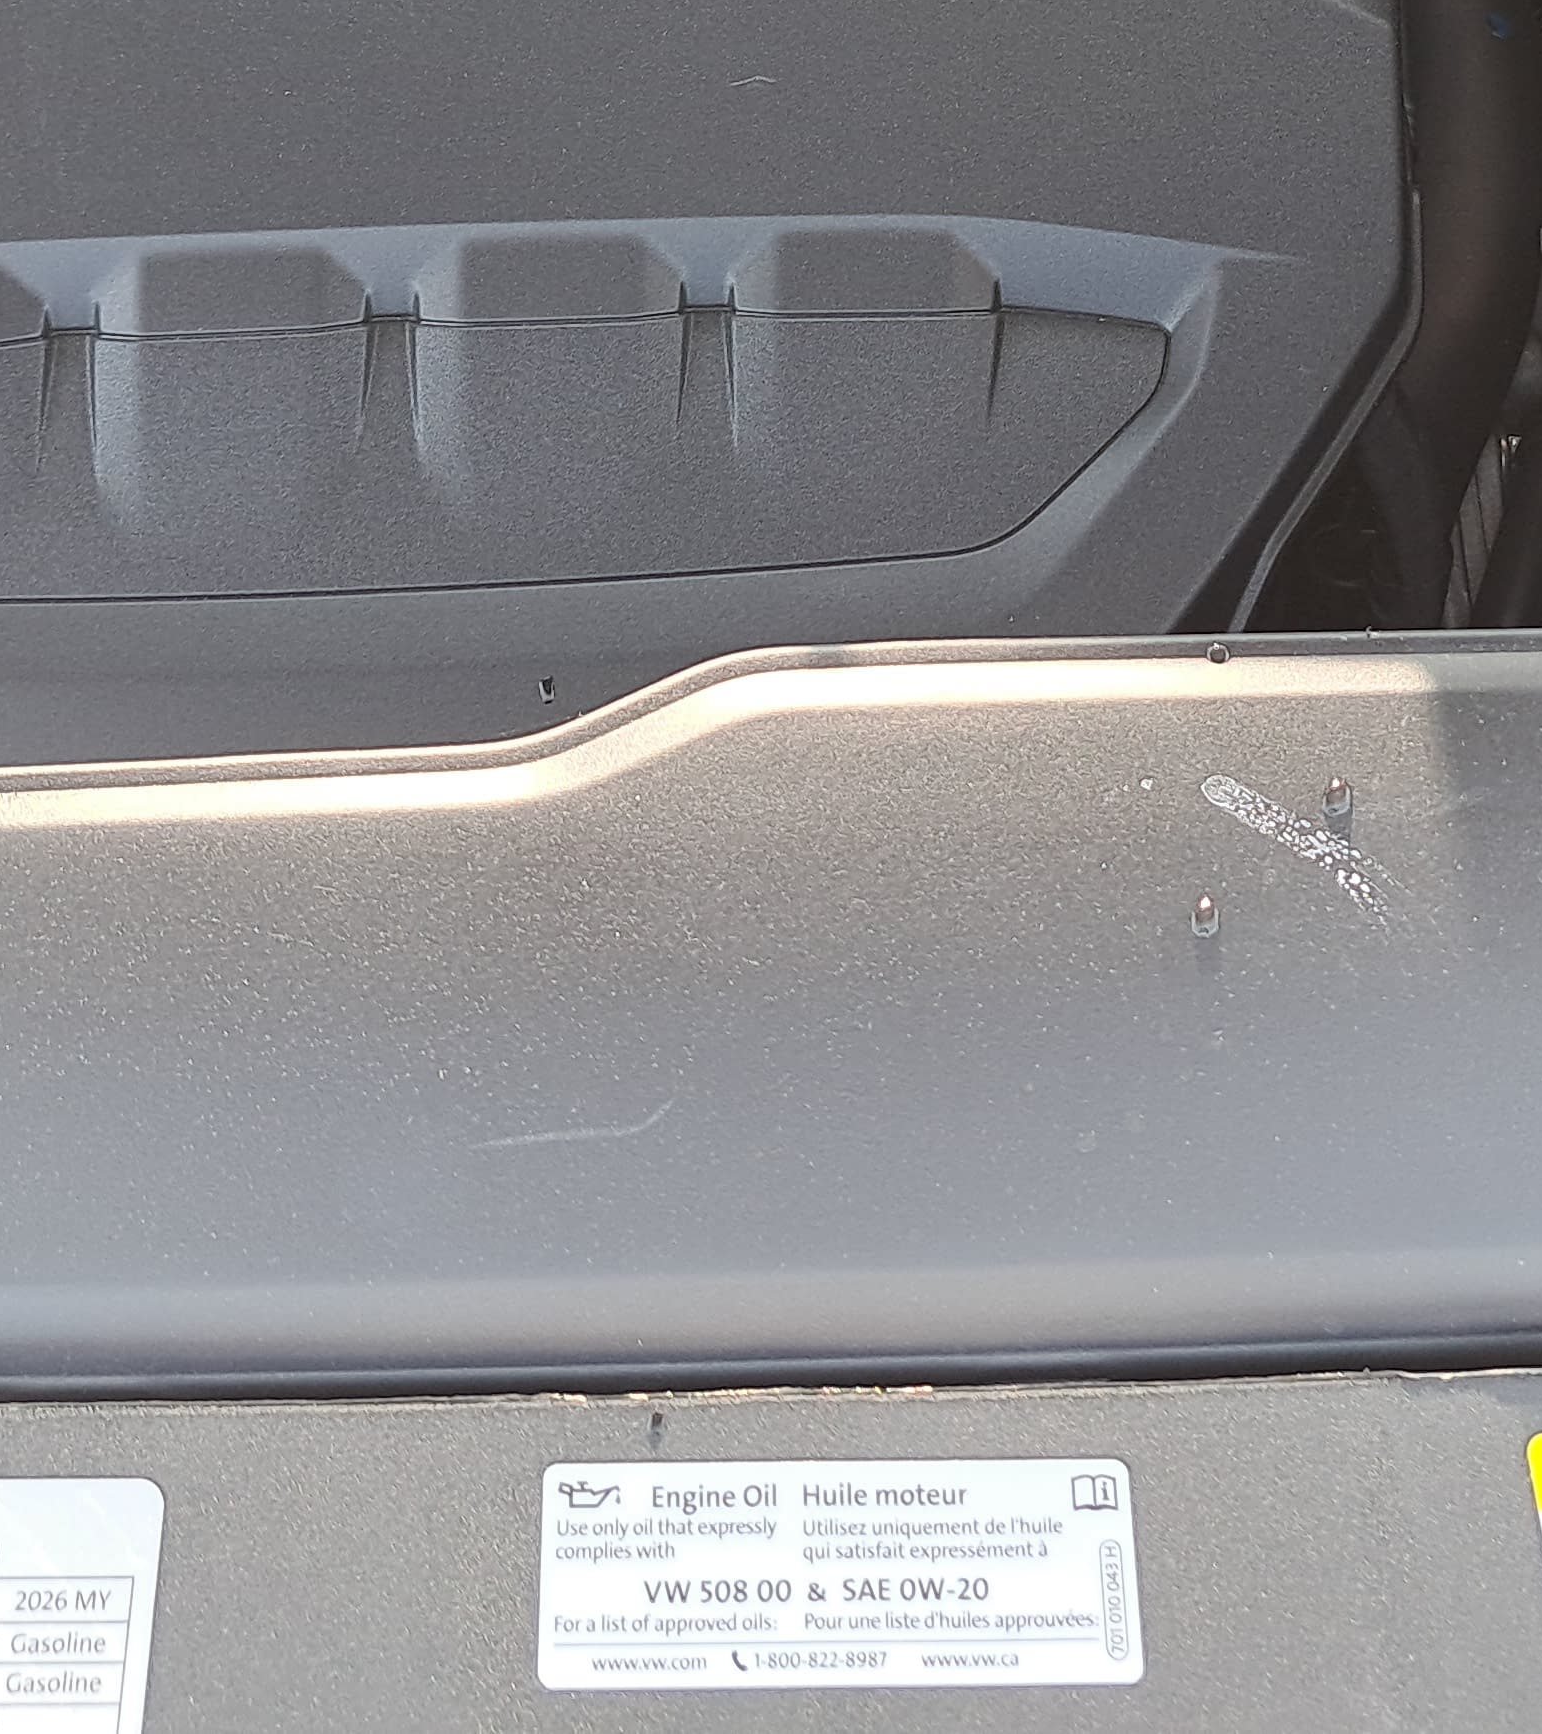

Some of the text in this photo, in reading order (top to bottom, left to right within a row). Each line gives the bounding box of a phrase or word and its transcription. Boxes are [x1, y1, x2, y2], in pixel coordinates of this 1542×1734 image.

[651, 1483, 778, 1516] Engine Oil
[802, 1482, 968, 1507] Huile moteur
[556, 1516, 778, 1540] Use only oil that expressly
[802, 1516, 1064, 1540] Utilisez uniquement de l'huile
[555, 1541, 676, 1565] complies with
[802, 1540, 1049, 1564] qui satisfait expressément à
[13, 1589, 69, 1613] 2026
[73, 1588, 112, 1611] MY
[643, 1577, 990, 1604] VW 508 00 & SAE 0W-20
[1104, 1545, 1126, 1655] 701 010 043 H
[554, 1612, 779, 1637] For a list of approved oils:
[804, 1609, 1101, 1634] Pour une liste d'huiles approuvées:
[9, 1631, 107, 1655] Gasoline
[591, 1650, 1021, 1672] www.vw.com 1-800-822-8987 www.vw.ca
[4, 1670, 103, 1694] Gasoline
